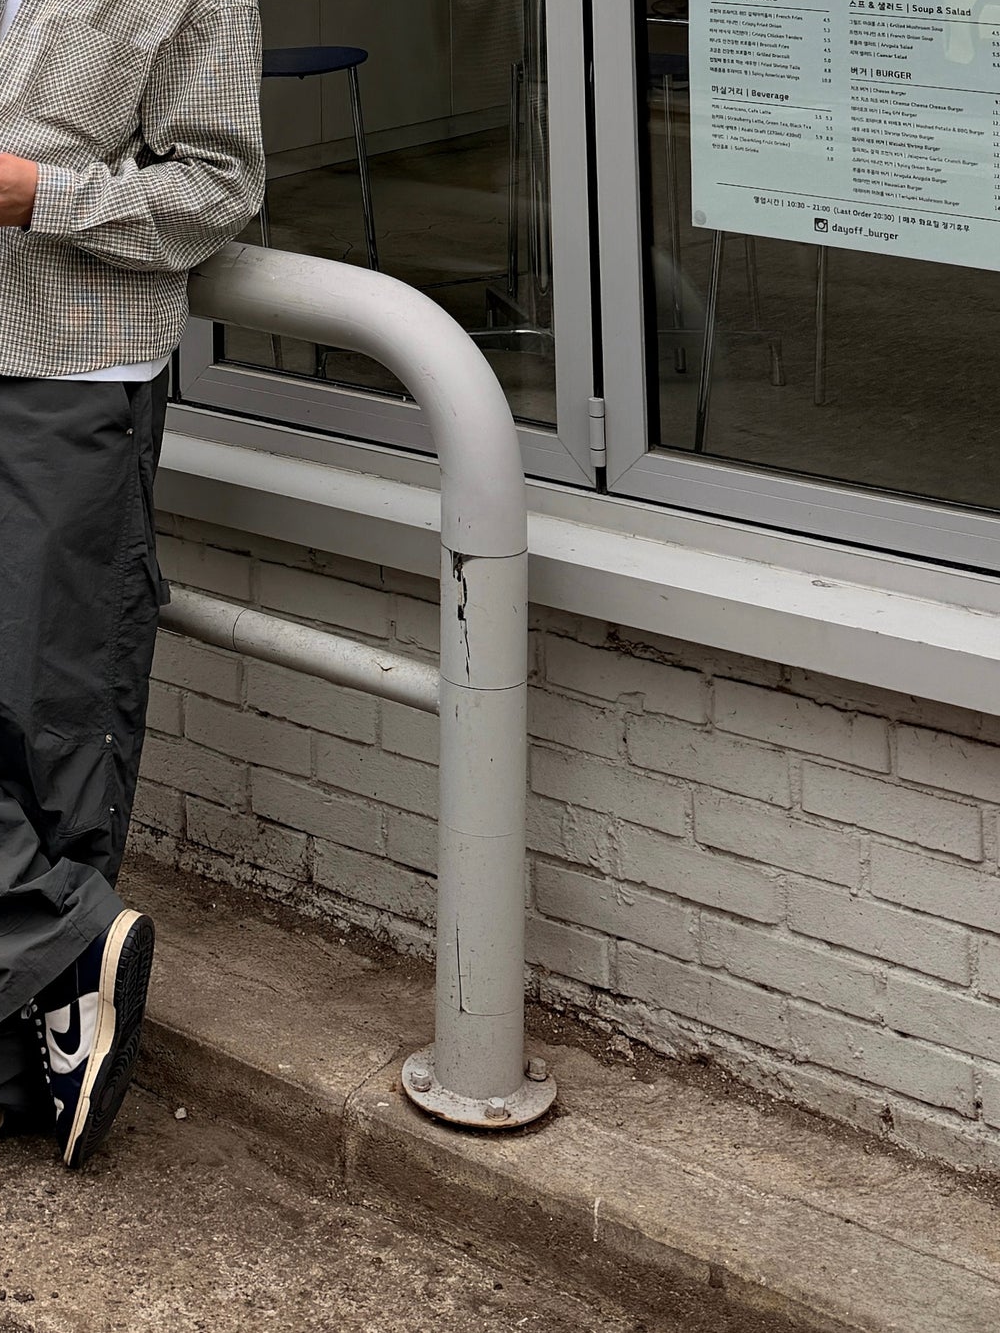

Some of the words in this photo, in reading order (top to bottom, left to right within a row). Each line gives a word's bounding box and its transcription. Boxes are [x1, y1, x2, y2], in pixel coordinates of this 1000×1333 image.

[849, 0, 865, 8] 스프
[878, 2, 903, 12] 샐러드
[912, 5, 934, 14] Soup
[946, 7, 971, 16] Salad
[850, 66, 867, 76] 버거
[876, 69, 911, 80] BURGER
[711, 85, 742, 96] 마실거리
[751, 90, 789, 102] Beverage
[754, 196, 779, 206] 영업시간
[788, 201, 805, 209] 10:30
[813, 204, 830, 212] 21:00
[833, 207, 850, 217] (Last
[853, 210, 871, 218] Order
[903, 216, 916, 224] 매주
[919, 218, 939, 228] 화요일
[832, 223, 899, 242] dayoff_burger
